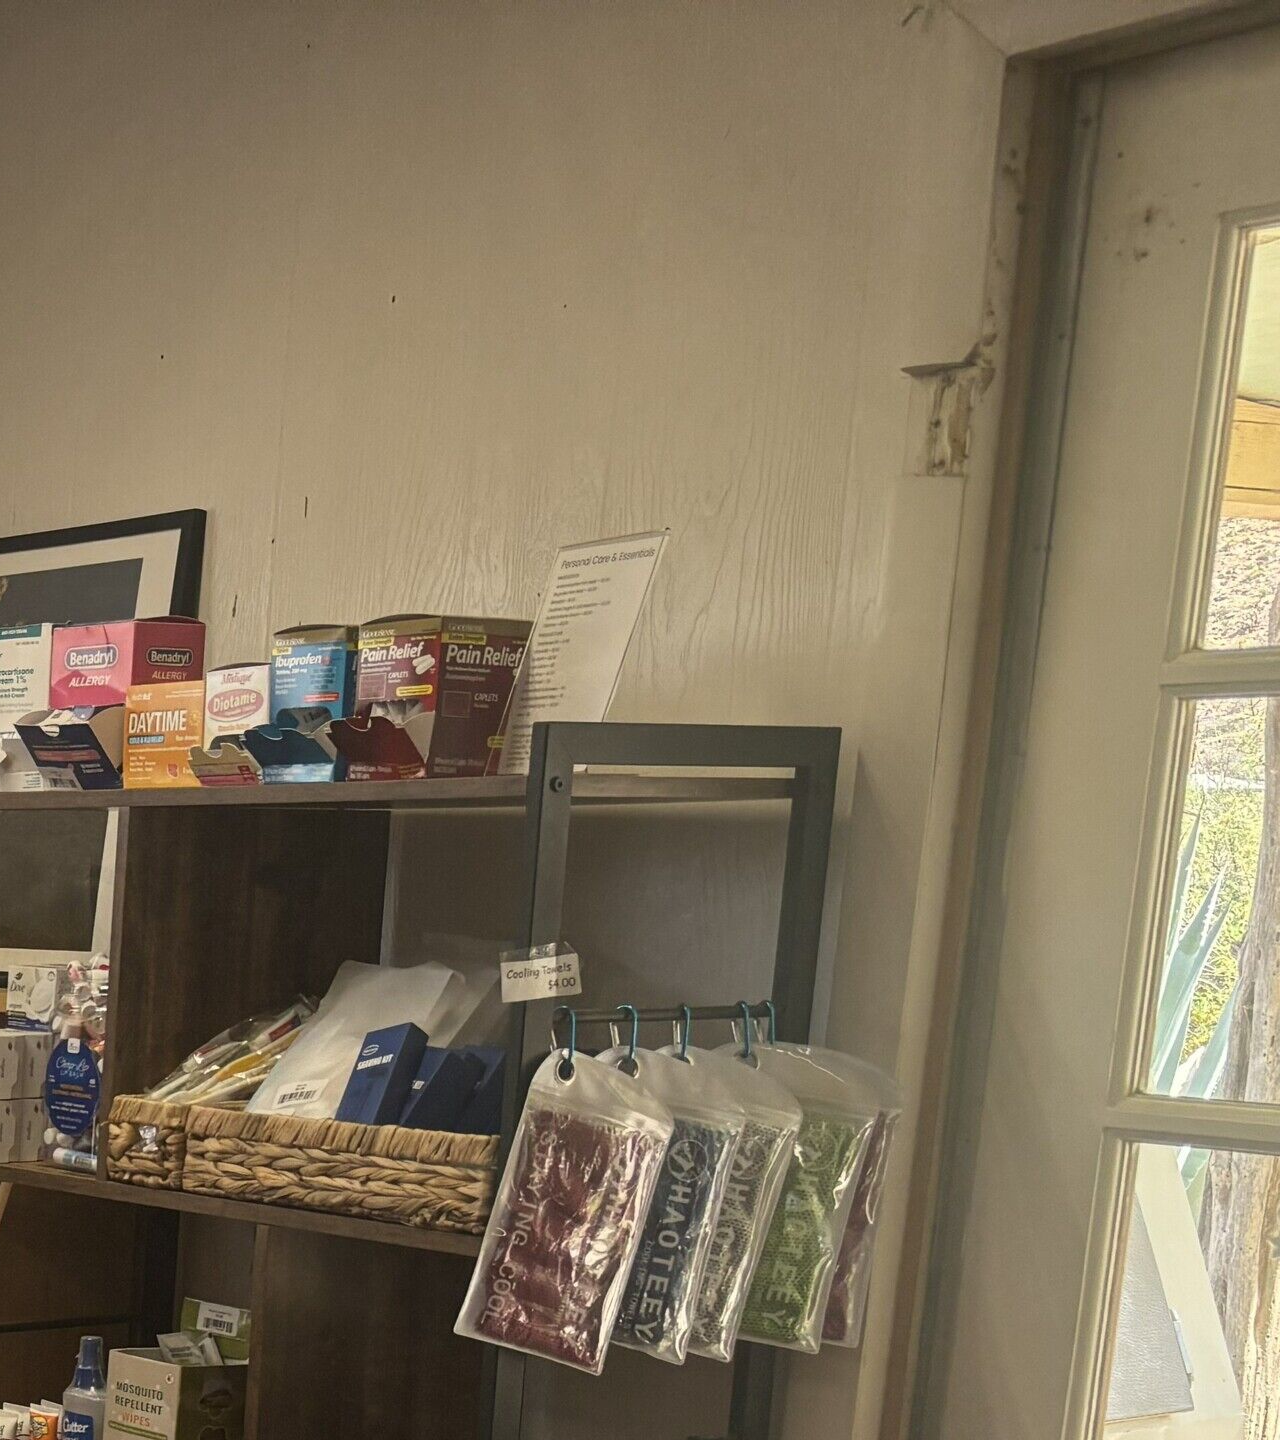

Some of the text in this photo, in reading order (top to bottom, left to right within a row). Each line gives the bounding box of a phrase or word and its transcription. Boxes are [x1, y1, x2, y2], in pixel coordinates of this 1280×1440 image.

[70, 648, 115, 666] Benadryl
[150, 650, 190, 665] Benadryl
[275, 653, 322, 668] Ibuprofen
[361, 642, 424, 662] Pain Relief
[446, 645, 523, 667] Pain Relief
[69, 674, 111, 687] ALLERGY
[152, 670, 188, 681] ALLERGY
[213, 692, 257, 711] Diotame
[129, 709, 187, 733] DAYTIME
[506, 962, 572, 981] Cooling Towels
[116, 1381, 164, 1401] MOSQUITO
[115, 1395, 163, 1416] REPELLENT
[63, 1418, 89, 1433] Cutter
[121, 1411, 151, 1428] WIPES
